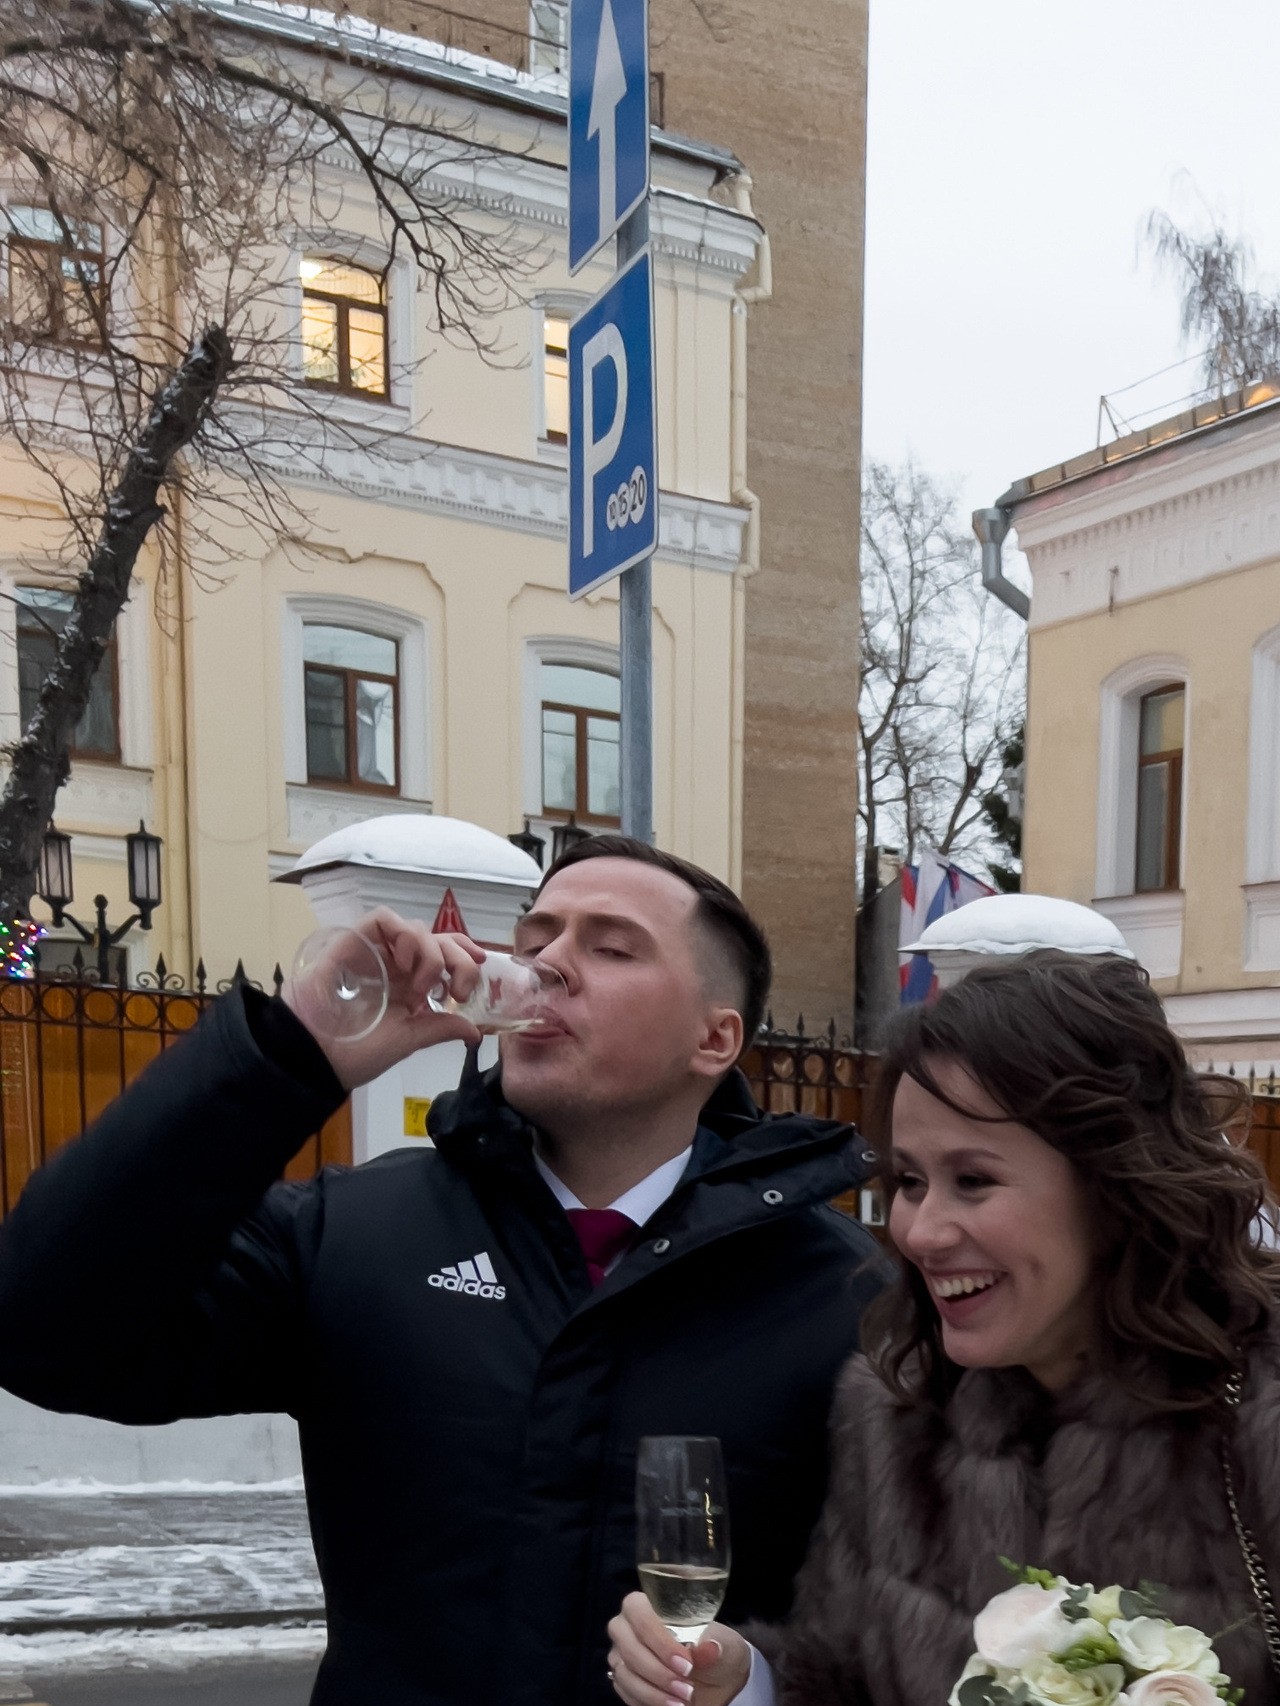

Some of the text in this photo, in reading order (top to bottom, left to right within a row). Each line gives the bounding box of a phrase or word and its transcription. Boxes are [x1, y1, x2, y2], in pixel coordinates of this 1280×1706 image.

[583, 322, 628, 558] P
[631, 474, 645, 511] 20
[427, 1274, 506, 1300] adidas
